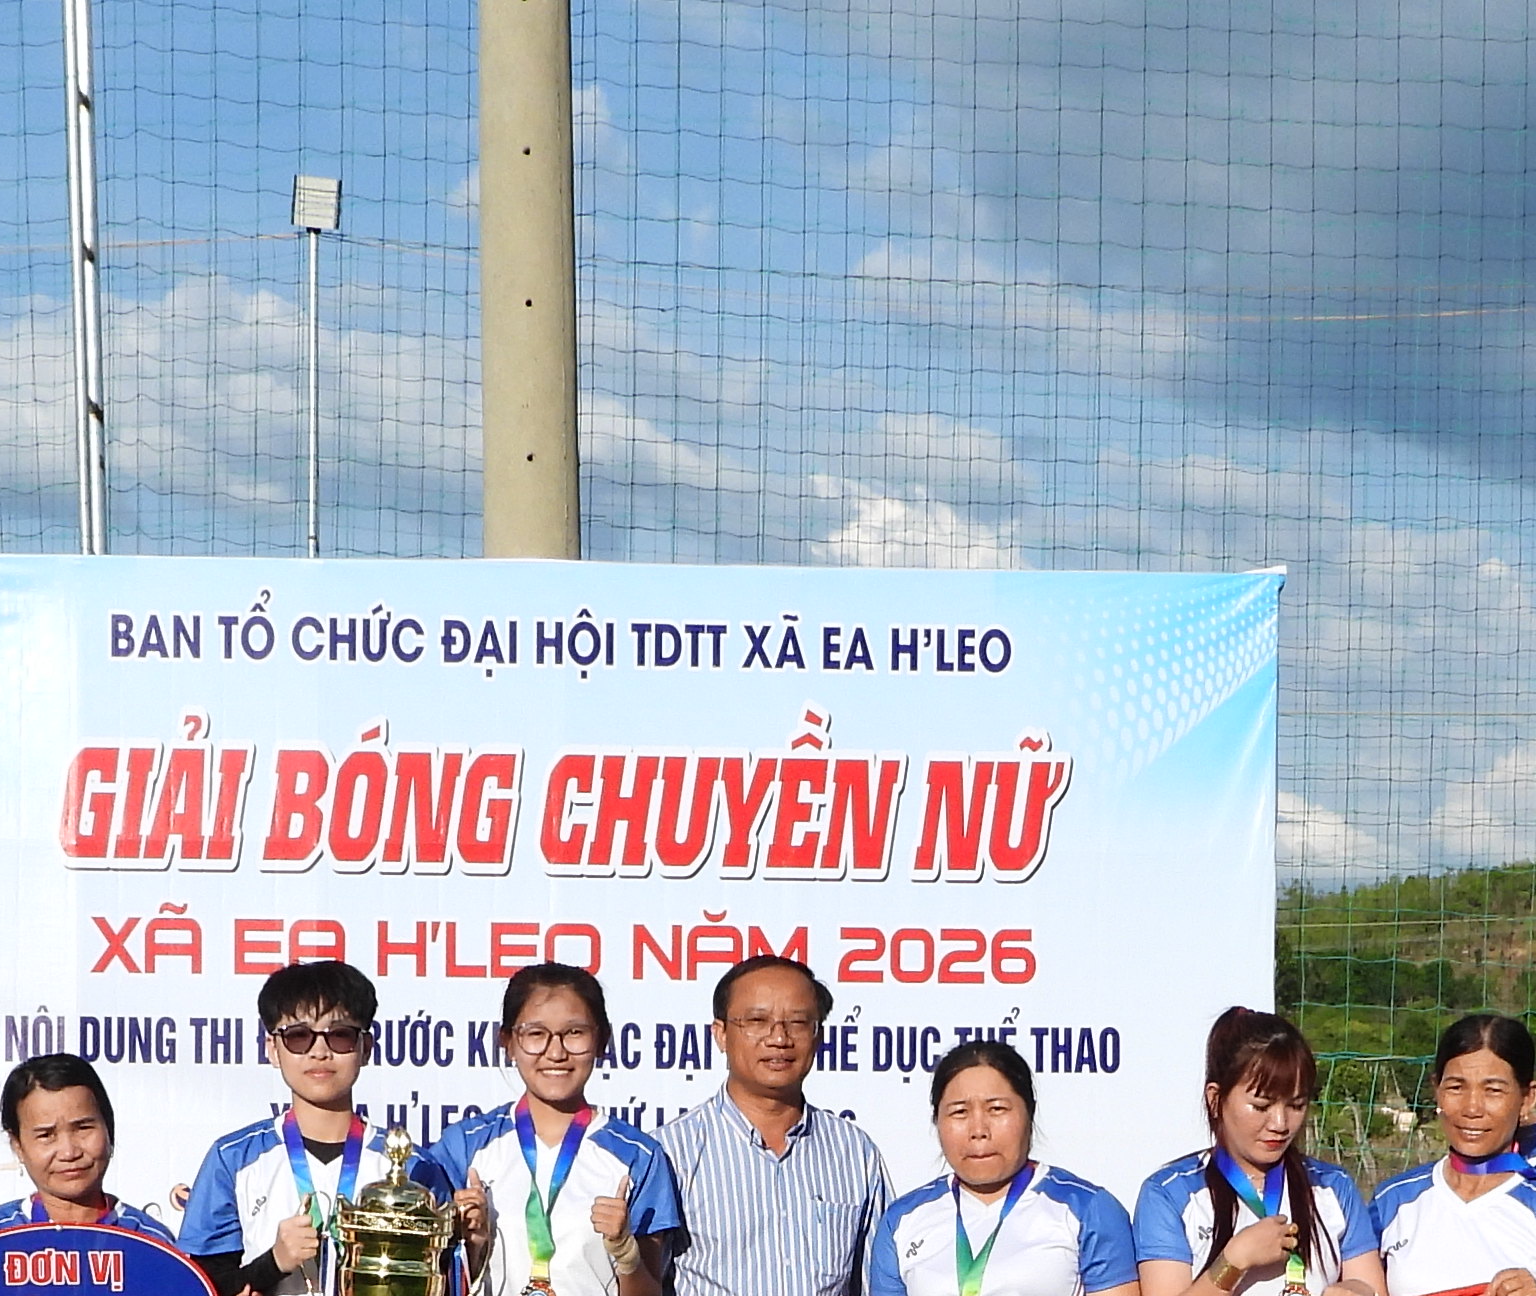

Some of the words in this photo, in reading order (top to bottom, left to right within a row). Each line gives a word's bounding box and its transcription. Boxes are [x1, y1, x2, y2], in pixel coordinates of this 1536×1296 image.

[110, 613, 202, 659] BAN
[217, 589, 275, 661] TỔ
[291, 604, 425, 663] CHỨC
[440, 619, 518, 678] ĐẠI
[535, 608, 615, 680] HỘI
[631, 622, 727, 668] TDTT
[742, 613, 806, 671] XÃ
[822, 626, 875, 672] EA
[890, 628, 1013, 674] H'LEO
[58, 713, 250, 862] GIẢI
[262, 724, 519, 866] BÓNG
[538, 708, 902, 872] CHUYỀN
[913, 734, 1067, 873] NỮ
[90, 901, 203, 975] XÃ
[234, 918, 346, 975] EA
[377, 919, 602, 979] H'LEO
[632, 908, 809, 981] NĂM
[837, 926, 1036, 985] 2026
[79, 1015, 177, 1065] DUNG
[189, 1017, 244, 1065] THI
[368, 1009, 455, 1067] RƯỚC
[654, 1023, 713, 1082] ĐẠI
[814, 1004, 862, 1073] HỂ
[872, 1025, 942, 1084] DỤC
[1030, 1026, 1121, 1074] THAO
[4, 1248, 80, 1286] ĐƠN
[88, 1250, 123, 1292] VỊ
